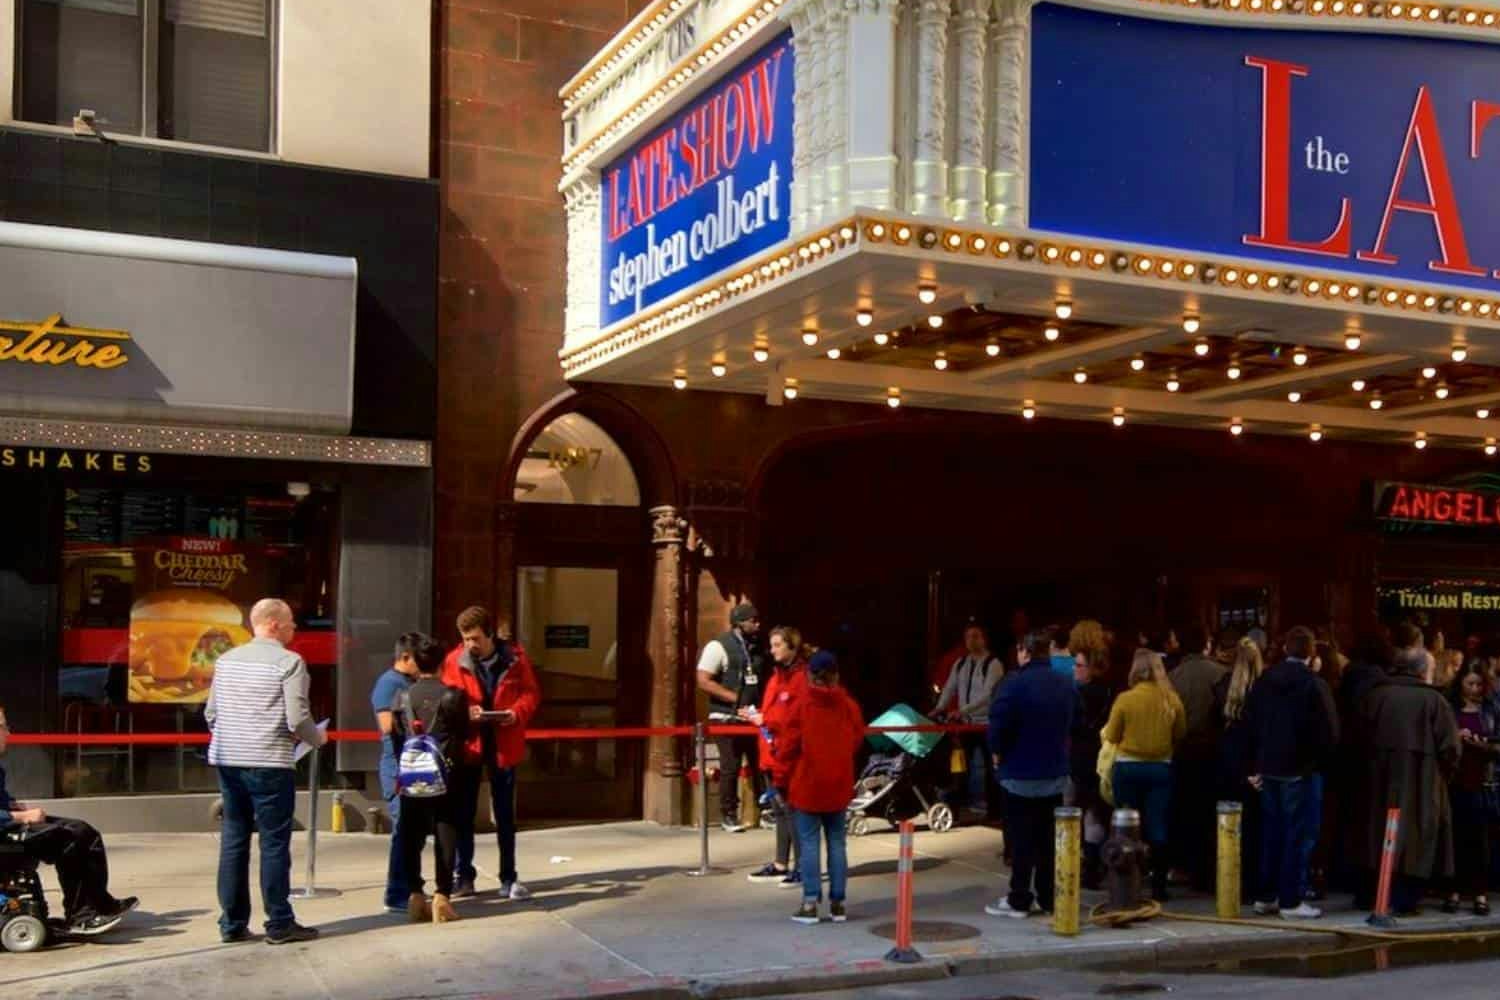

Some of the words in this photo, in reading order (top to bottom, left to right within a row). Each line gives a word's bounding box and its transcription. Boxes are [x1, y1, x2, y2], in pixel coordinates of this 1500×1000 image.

[607, 126, 679, 242] LATE
[678, 47, 786, 197] SHOW
[1304, 136, 1350, 175] the
[609, 224, 688, 312] stephen
[689, 160, 780, 262] colbert
[1, 449, 152, 473] SHAKES
[181, 538, 221, 552] NEW!
[153, 551, 248, 574] CHEDDAR
[1400, 591, 1458, 609] ITALIAN
